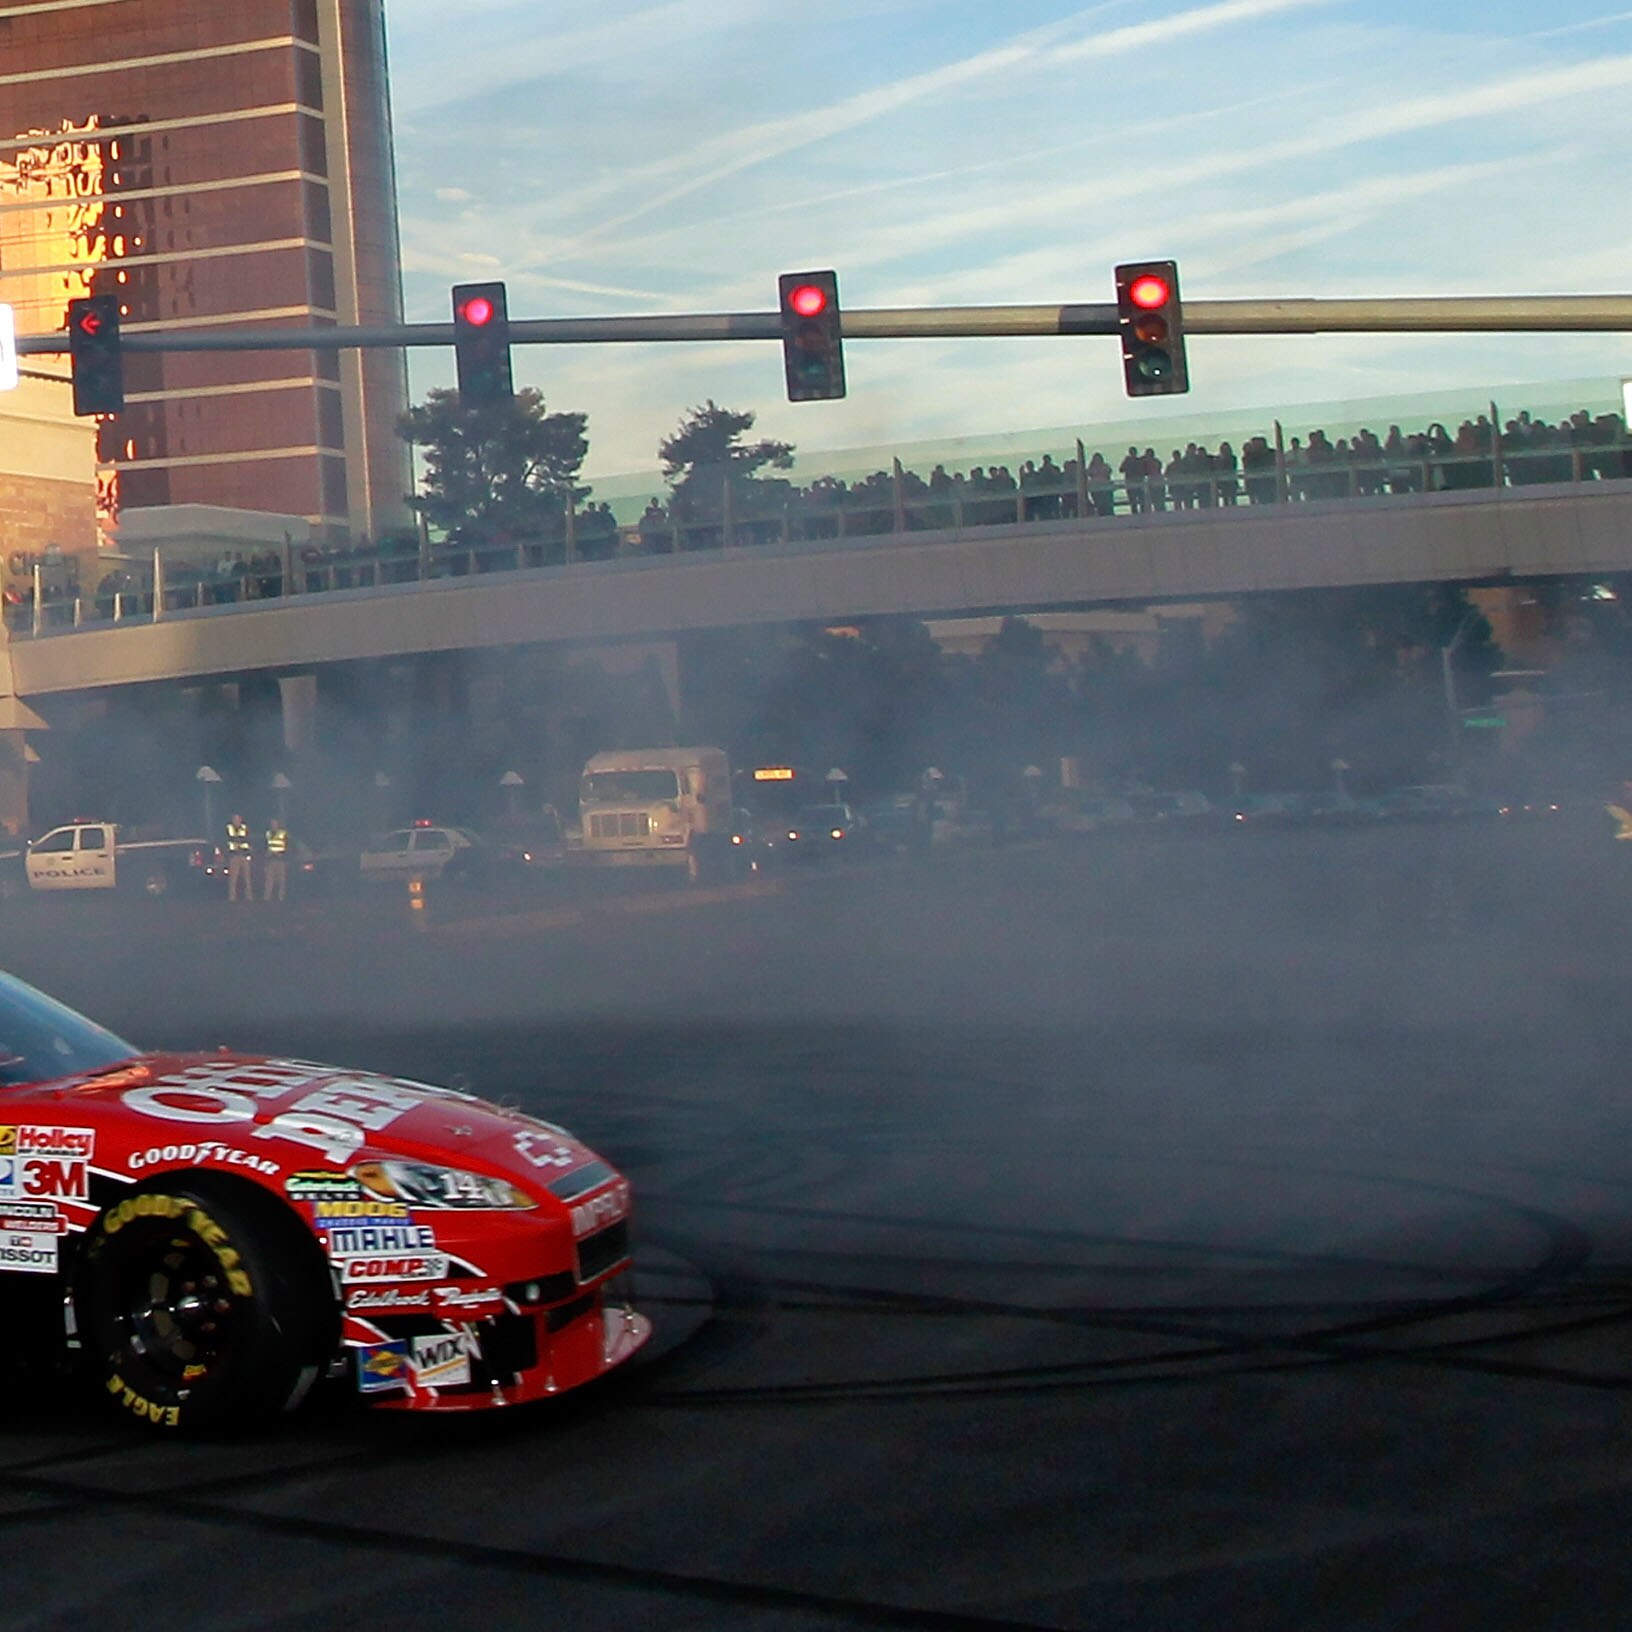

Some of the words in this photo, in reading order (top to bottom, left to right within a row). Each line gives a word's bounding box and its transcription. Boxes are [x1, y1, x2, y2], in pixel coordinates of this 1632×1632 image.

[19, 1127, 92, 1156] Holley
[128, 1142, 281, 1176] GOODYEAR
[23, 1159, 86, 1197] 3M
[440, 1171, 486, 1199] 14
[333, 1229, 434, 1252] MAHLE
